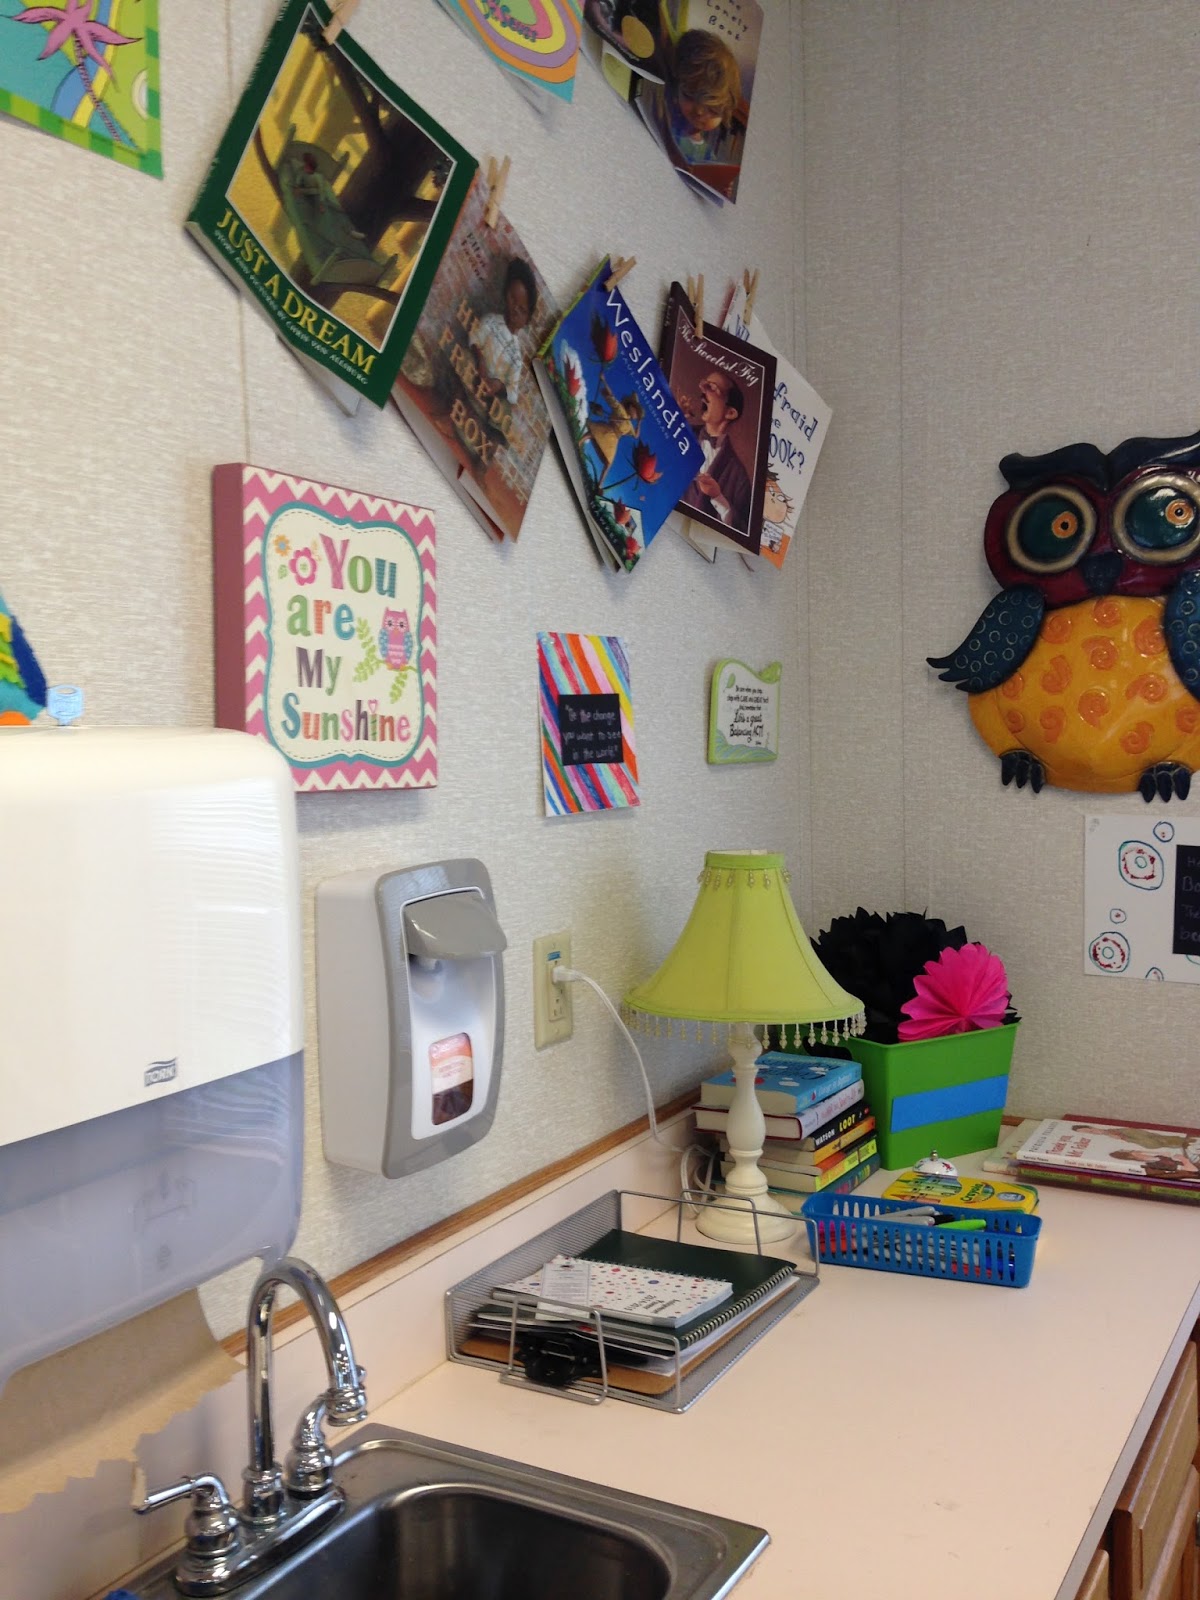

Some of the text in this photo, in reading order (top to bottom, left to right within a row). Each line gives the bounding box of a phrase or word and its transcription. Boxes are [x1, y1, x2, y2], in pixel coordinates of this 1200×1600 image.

[708, 15, 741, 41] Book
[216, 207, 377, 376] JUST A DREAM
[605, 287, 691, 457] Weslandia
[690, 335, 738, 372] Sweetest
[735, 361, 760, 388] Fig
[450, 398, 493, 466] BOX
[772, 381, 819, 442] fraid
[768, 432, 806, 475] OOK?
[319, 532, 397, 599] You
[286, 594, 356, 641] are
[296, 646, 342, 696] My
[281, 692, 411, 742] Sunshine
[562, 731, 575, 746] you
[592, 709, 616, 726] change
[144, 1066, 176, 1087] TORK
[815, 1128, 836, 1146] WATSON
[839, 1113, 856, 1132] LOOT
